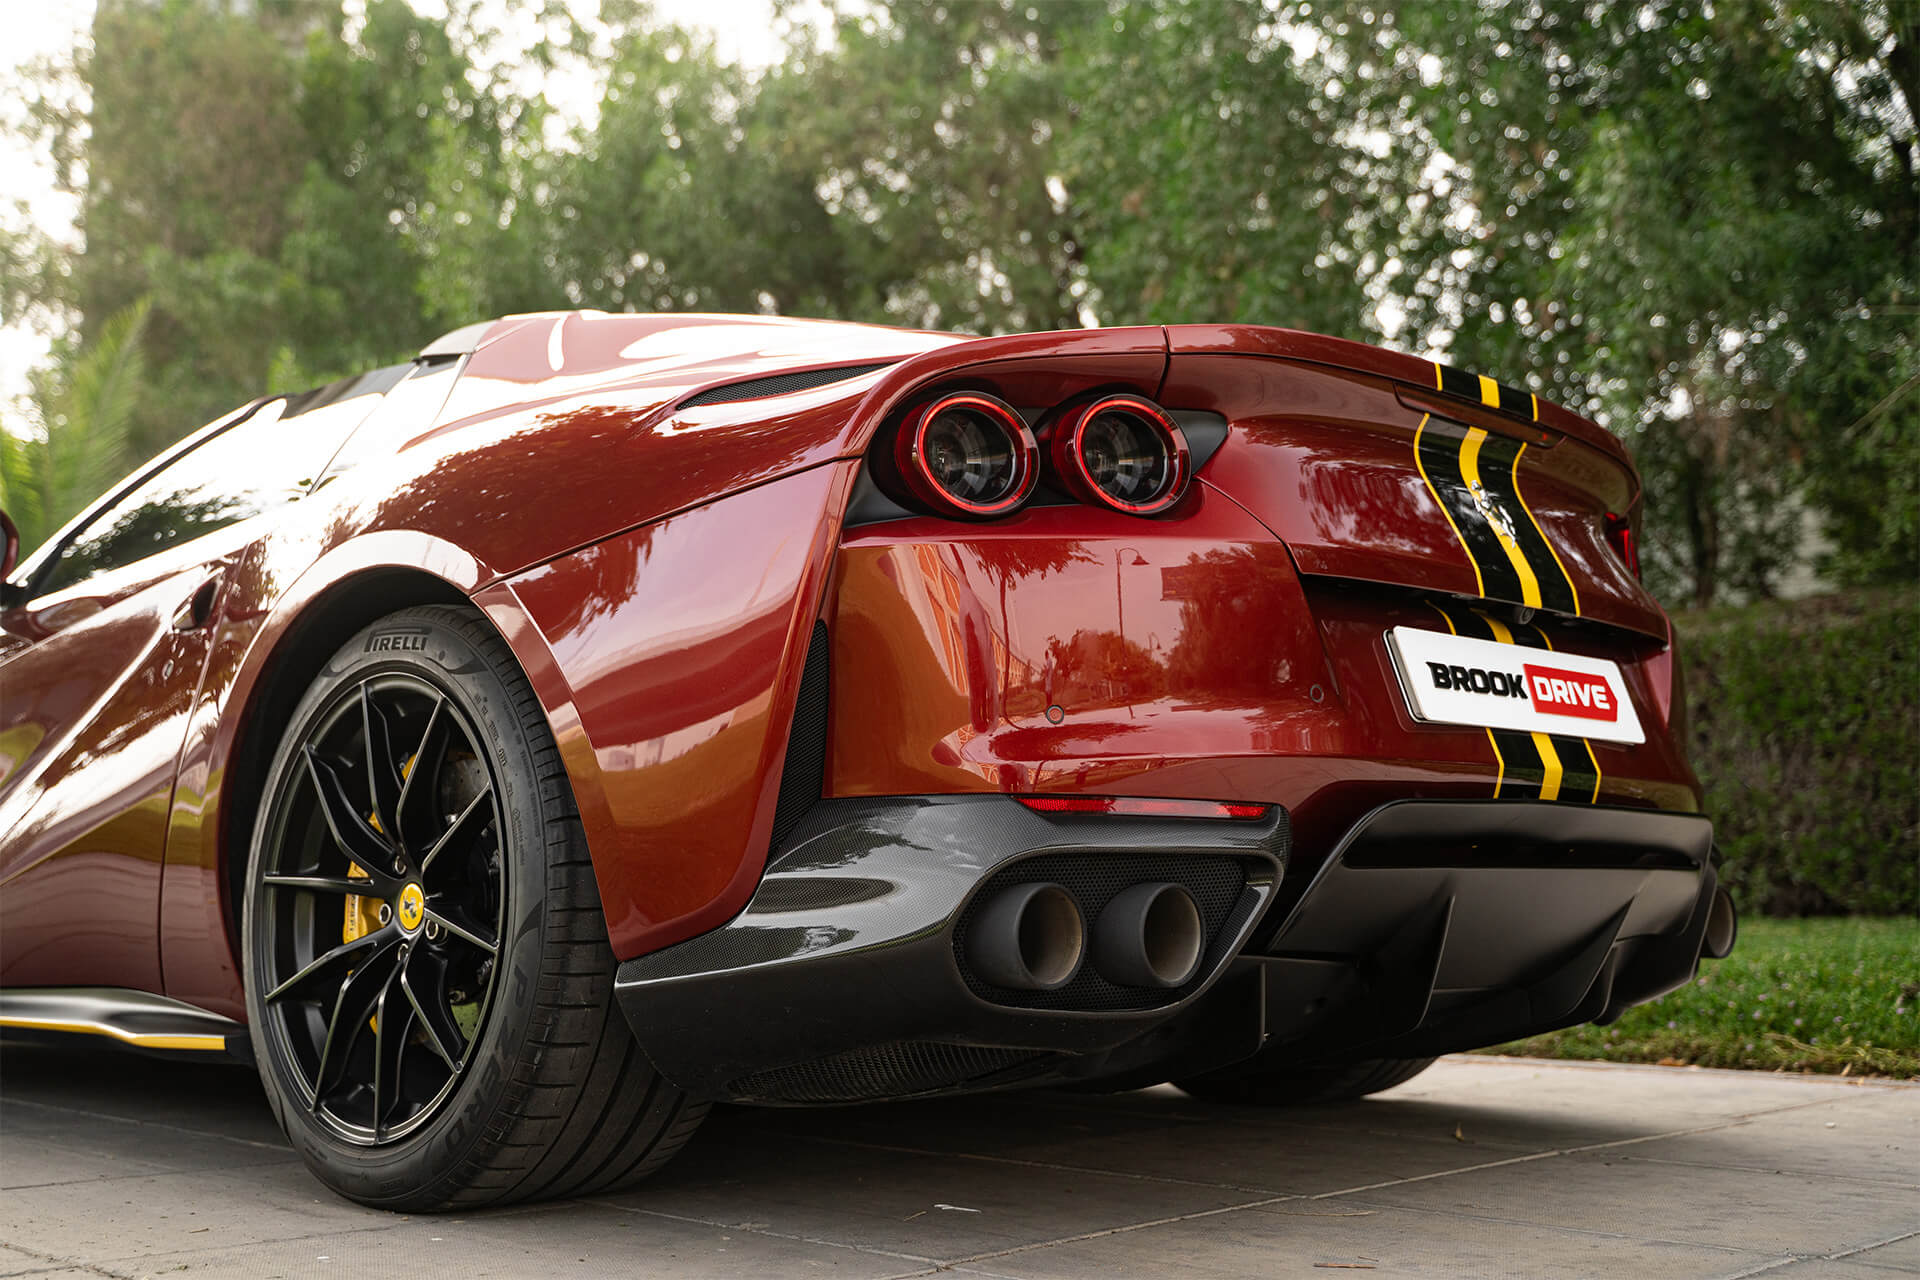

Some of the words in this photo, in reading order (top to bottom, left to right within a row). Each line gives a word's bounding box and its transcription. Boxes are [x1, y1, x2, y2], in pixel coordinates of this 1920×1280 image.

[364, 627, 432, 652] PIRELLI
[1426, 661, 1528, 699] BROOK
[1532, 676, 1610, 710] DRIVE
